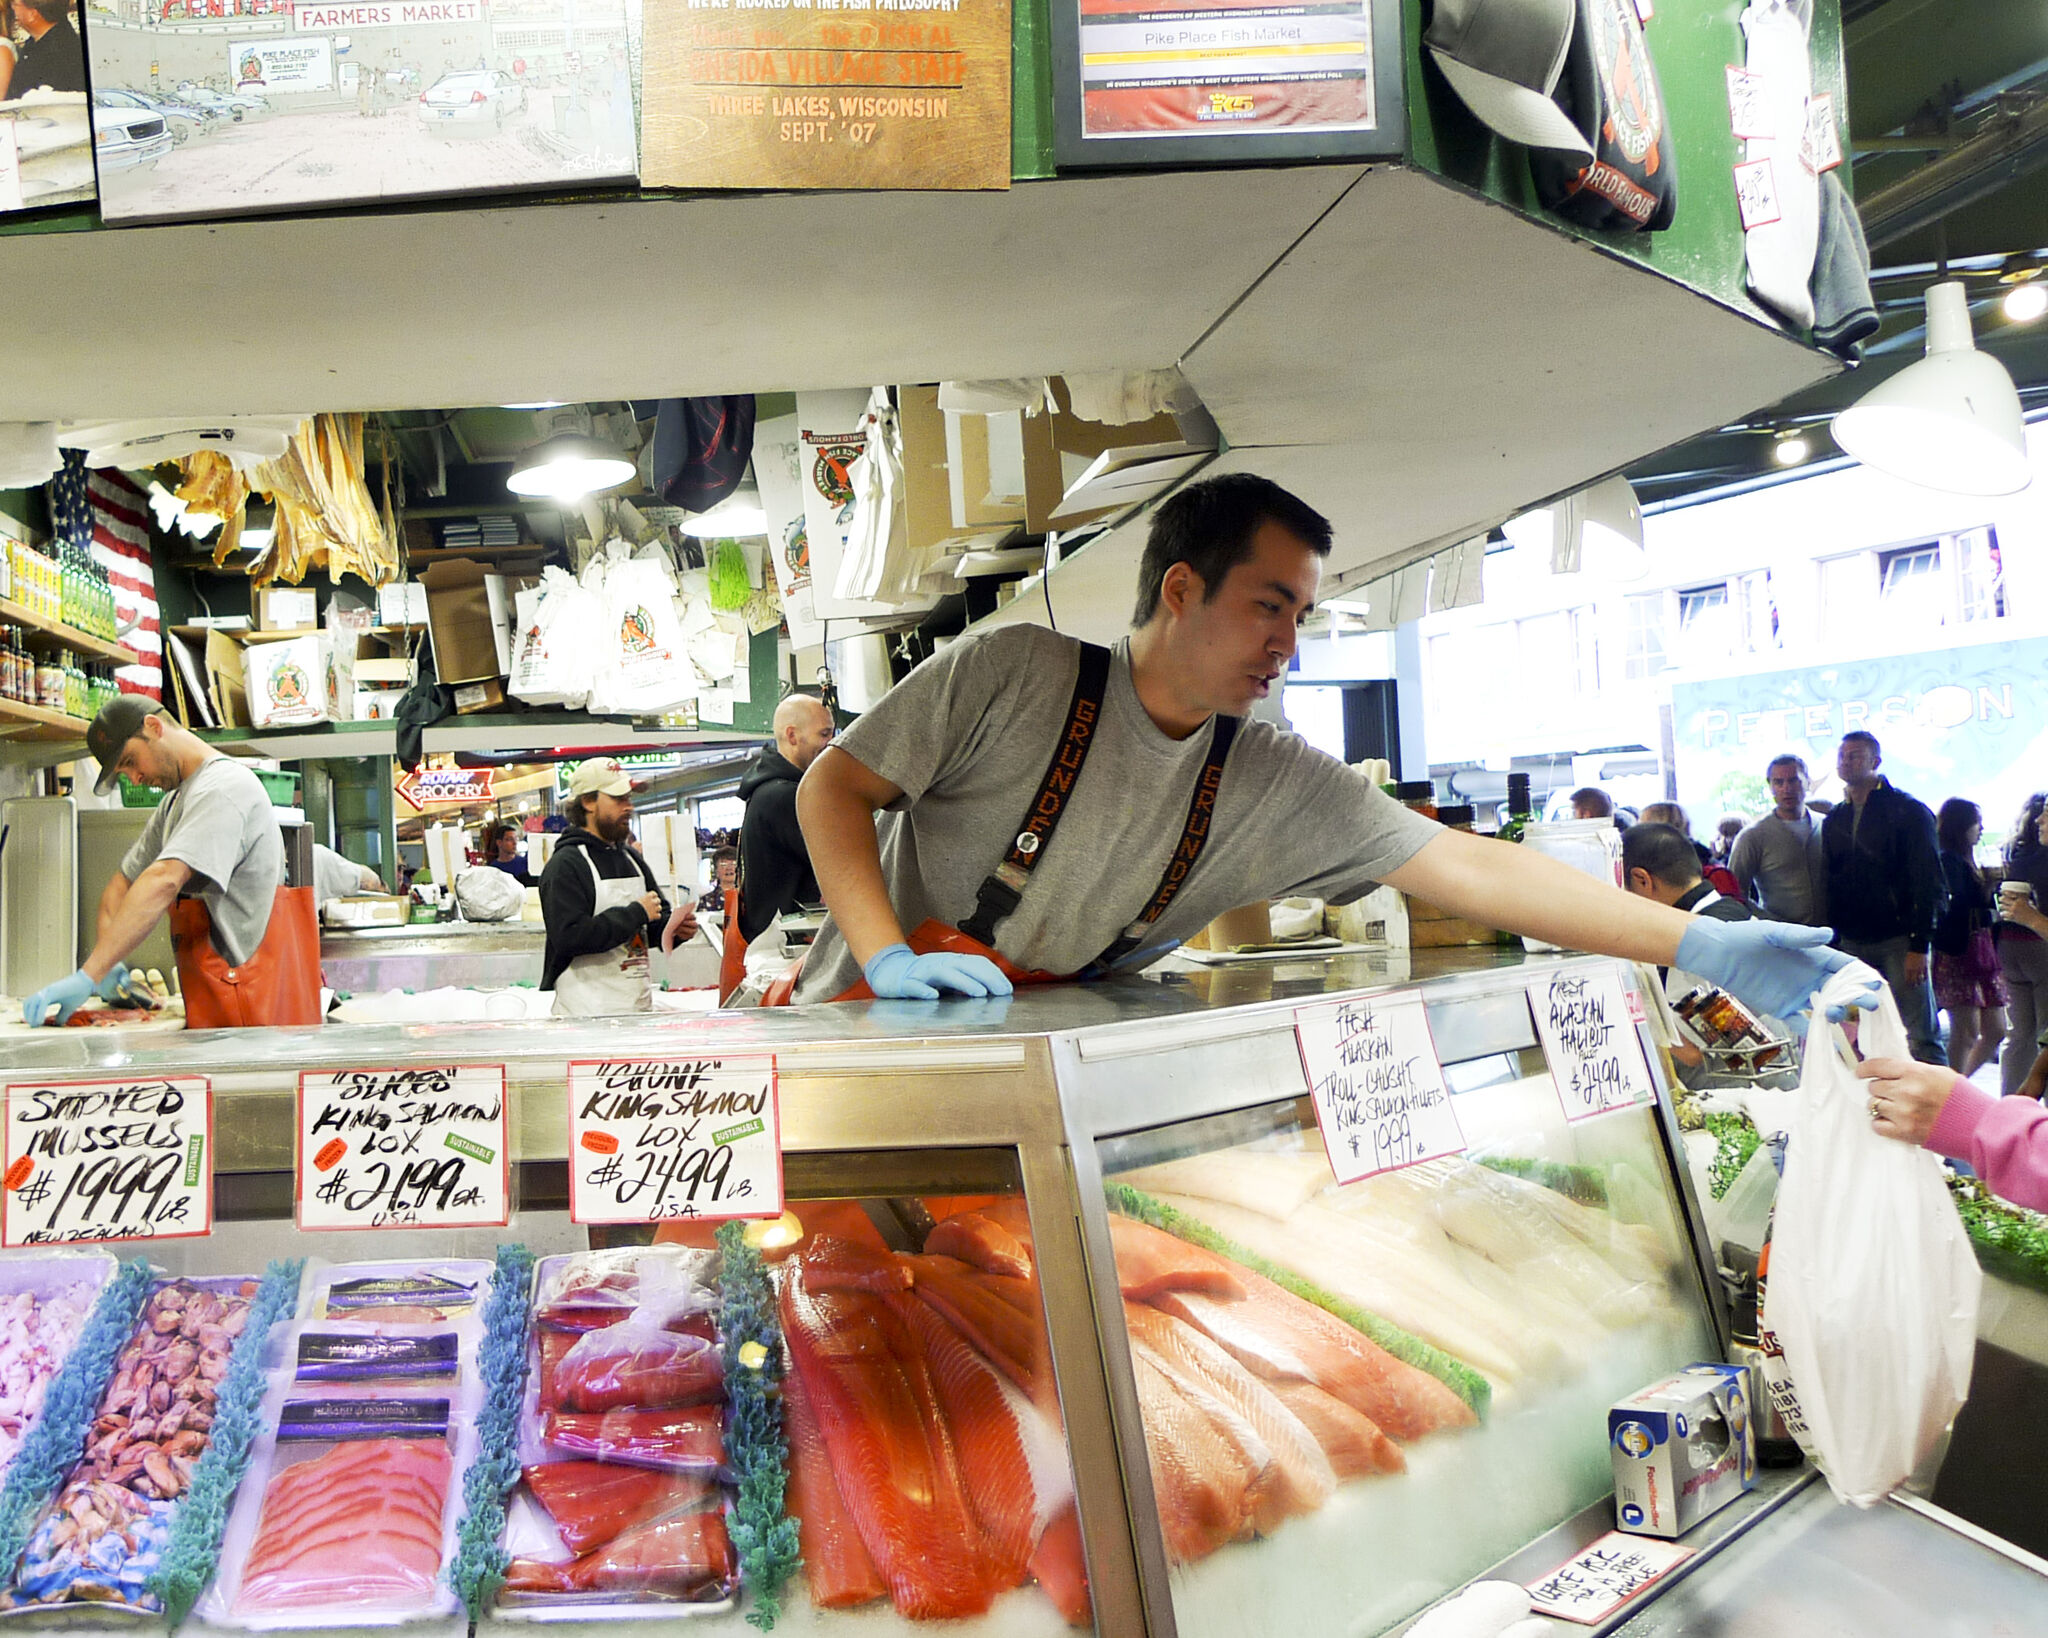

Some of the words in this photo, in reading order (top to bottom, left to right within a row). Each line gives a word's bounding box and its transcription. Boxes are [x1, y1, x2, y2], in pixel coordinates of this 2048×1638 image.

[302, 8, 392, 28] FARMERS
[402, 3, 476, 22] MARKET
[1145, 33, 1174, 45] Pike
[1179, 31, 1216, 44] Place
[1222, 29, 1250, 41] Fish
[1255, 27, 1301, 40] Market
[787, 53, 888, 83] VILLAGE
[899, 53, 968, 84] STAFF
[709, 96, 764, 115] THREE
[773, 96, 835, 119] LAKES,
[839, 97, 948, 118] WISCONSIN
[780, 121, 833, 143] SEPT.
[841, 122, 877, 144] '07
[1614, 178, 1655, 219] FAMOUS
[409, 782, 485, 799] GROCERY
[419, 772, 473, 785] ROTARY
[1550, 993, 1605, 1030] ALASKAN
[1560, 1025, 1615, 1054] HALIBUT
[17, 1081, 184, 1122] SMOKED
[311, 1103, 393, 1135] KING
[394, 1094, 502, 1126] SALMON
[579, 1091, 664, 1121] KING
[665, 1084, 768, 1118] SALMON
[1335, 1097, 1367, 1132] KING
[26, 1118, 185, 1158] MUSSELS
[360, 1129, 422, 1155] LOX
[635, 1118, 702, 1149] LOX
[715, 1121, 760, 1142] SUSTAINABLE
[186, 1137, 201, 1183] SUSTAINABLE
[449, 1135, 492, 1159] SUSTAINABLE
[23, 1230, 62, 1246] NEW
[1647, 1466, 1660, 1529] FoodHandler
[1625, 1509, 1640, 1520] L
[1576, 1550, 1621, 1573] ASK
